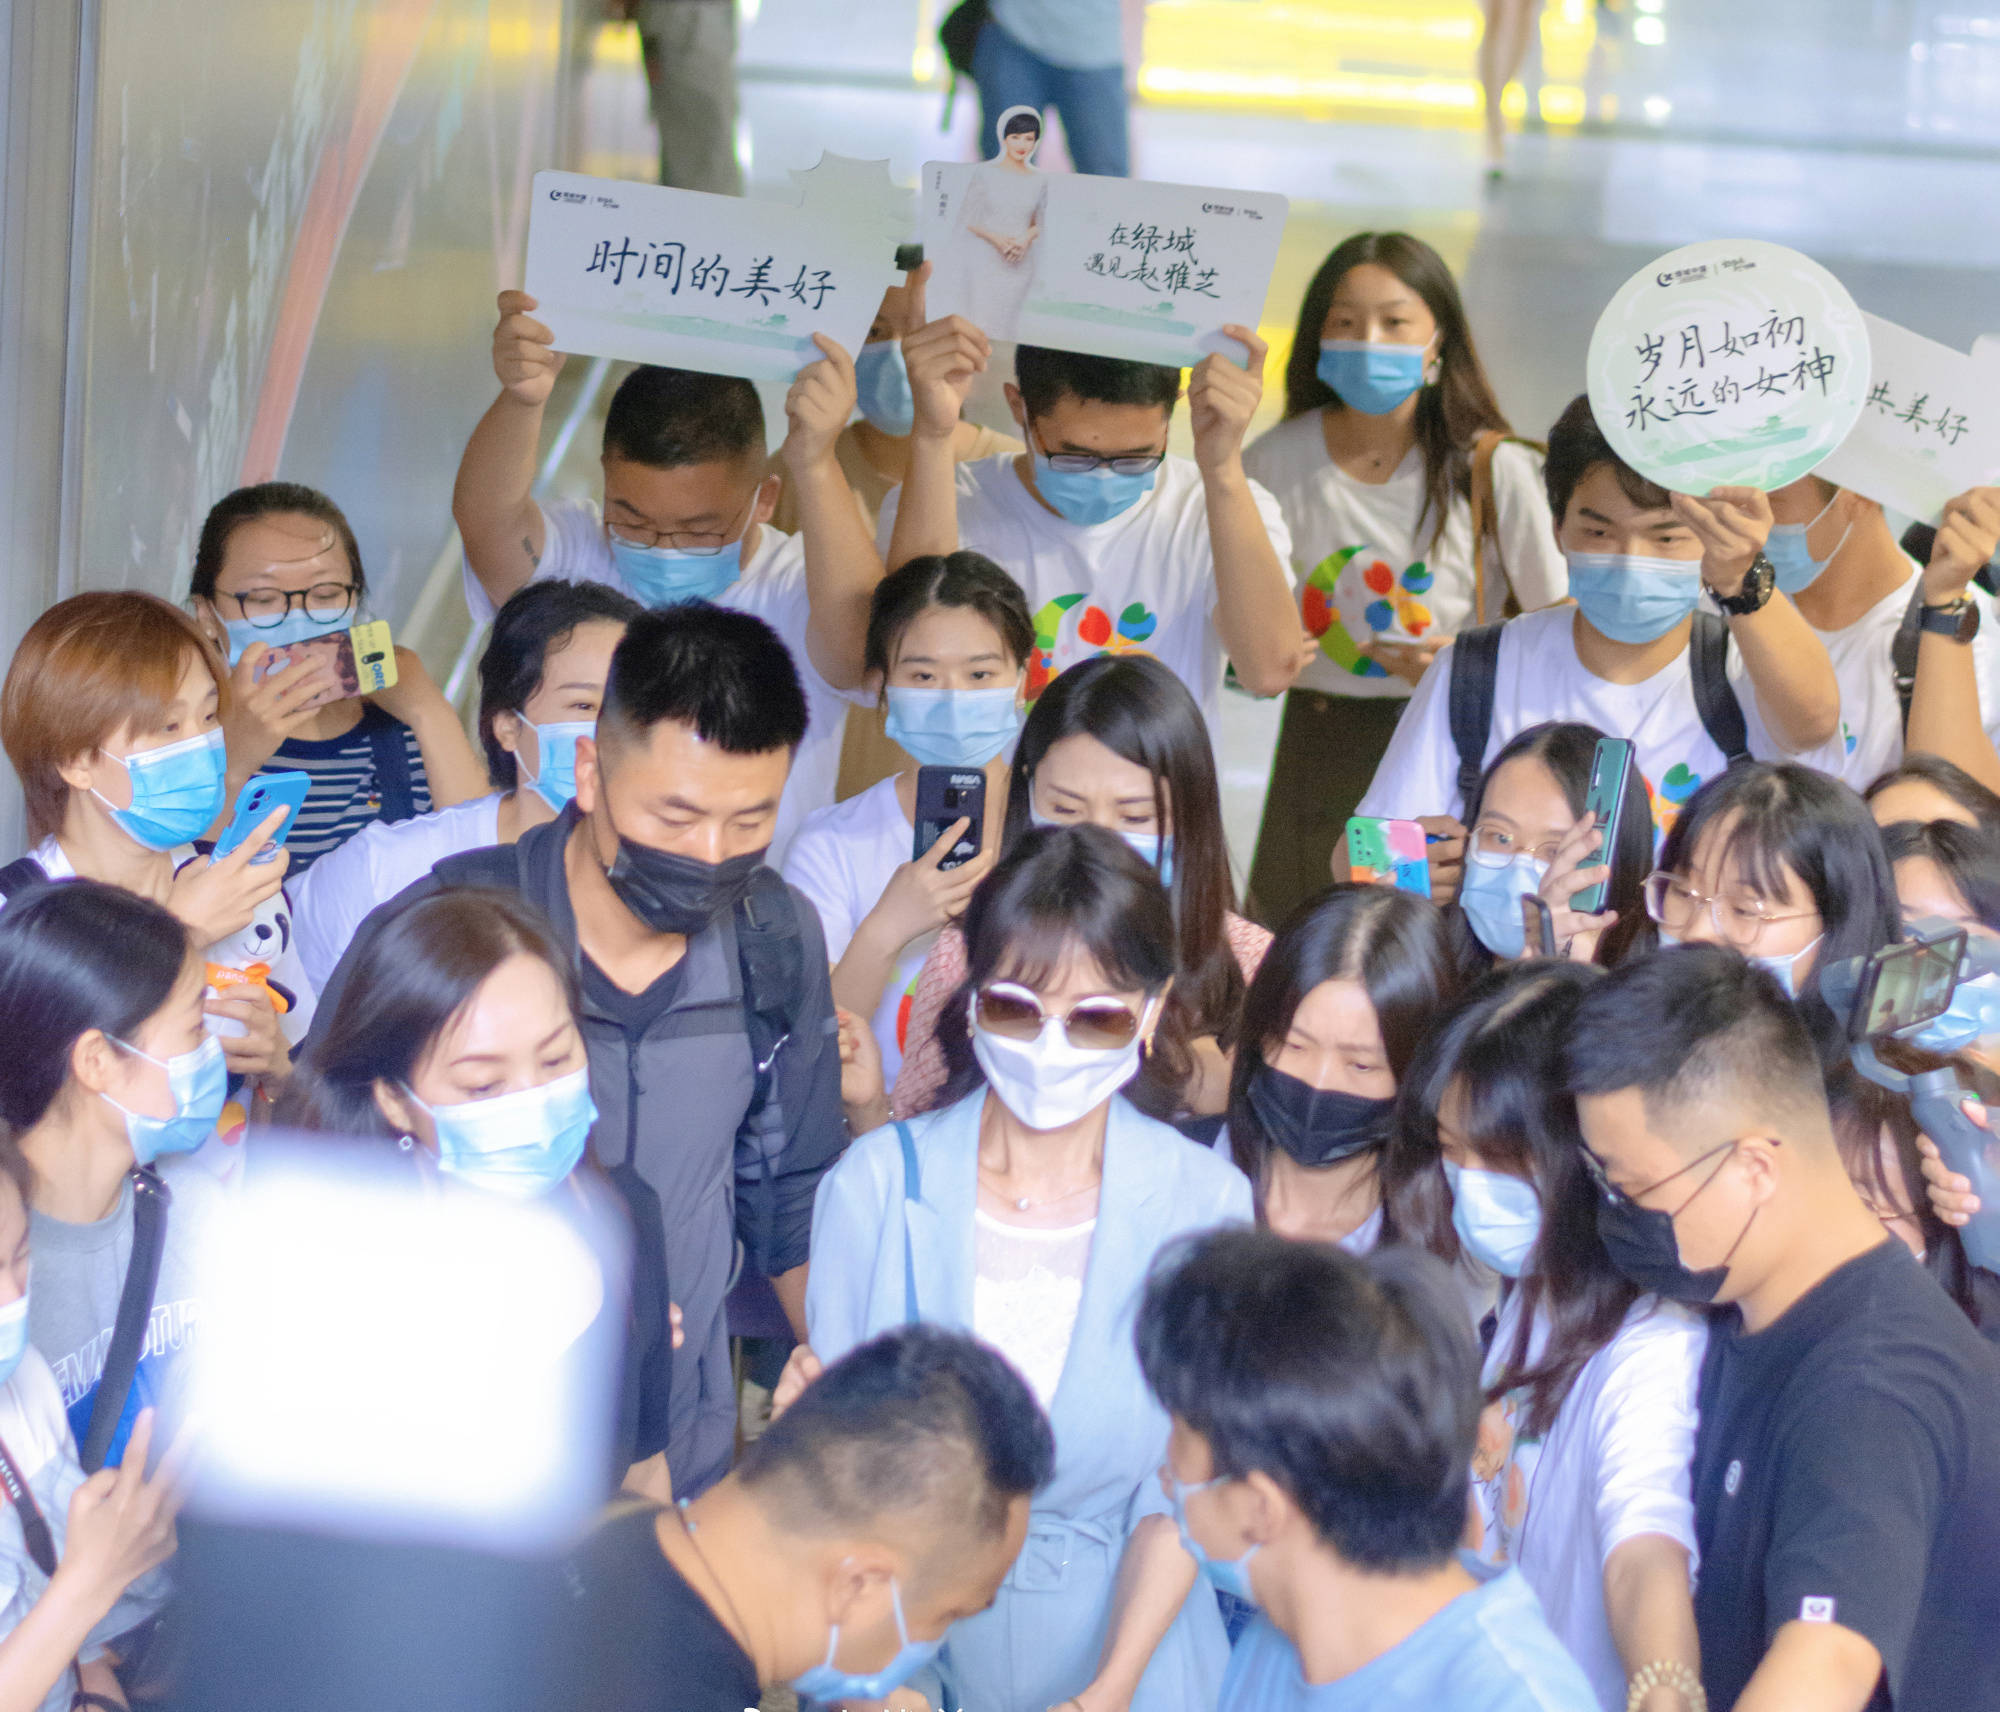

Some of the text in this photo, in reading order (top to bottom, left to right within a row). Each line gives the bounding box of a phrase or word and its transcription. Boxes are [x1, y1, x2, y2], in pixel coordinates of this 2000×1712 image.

[585, 236, 837, 310] 时间的美好
[1084, 254, 1221, 299] 遇见赵雅芝
[1108, 222, 1199, 266] 在绿城
[1634, 309, 1806, 383] 岁月如初
[1625, 346, 1836, 432] 永远的女神
[1866, 380, 1969, 446] 共美好
